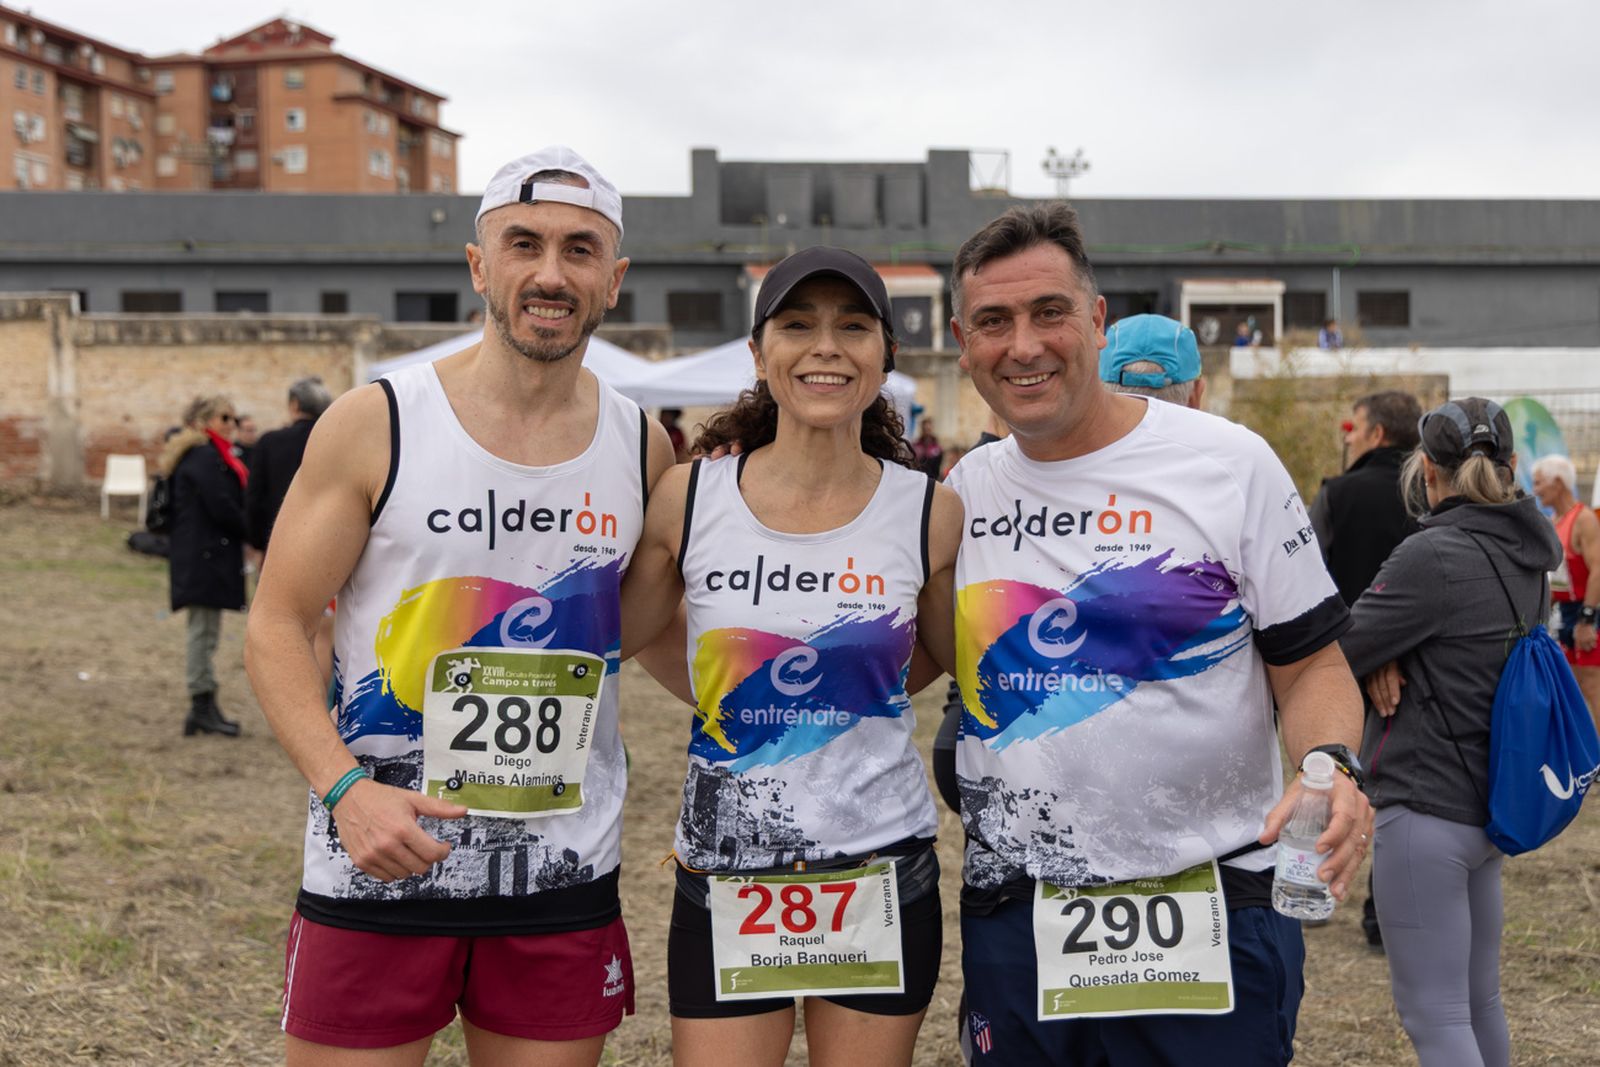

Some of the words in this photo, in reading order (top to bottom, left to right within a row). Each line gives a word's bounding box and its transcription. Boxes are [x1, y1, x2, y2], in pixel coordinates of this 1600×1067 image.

[427, 489, 617, 550] calderón
[970, 494, 1153, 551] calderón
[573, 543, 598, 554] desde
[600, 545, 617, 556] 1949
[1094, 543, 1124, 552] desde
[1129, 543, 1152, 552] 1949
[1282, 539, 1299, 554] Da
[706, 555, 885, 606] calderón
[837, 601, 863, 610] desde
[868, 602, 886, 611] 1949
[482, 676, 520, 688] Campo
[532, 679, 557, 688] través
[998, 666, 1123, 692] entrénate
[740, 702, 850, 726] entrénate
[449, 695, 562, 754] 288
[575, 703, 593, 750] Veterano
[494, 754, 532, 769] Diego
[455, 769, 505, 786] Mañas
[510, 773, 564, 786] Alaminos
[1205, 886, 1217, 894] C
[737, 881, 857, 935] 287
[882, 878, 894, 928] Veterana
[1060, 895, 1184, 955] 290
[1211, 896, 1221, 947] Veterano
[780, 934, 825, 948] Raquel
[751, 953, 792, 969] Borja
[798, 950, 868, 965] Banqueri
[1088, 953, 1127, 966] Pedro
[1132, 951, 1164, 963] Jose
[1069, 970, 1139, 988] Quesada
[1143, 968, 1200, 982] Gomez
